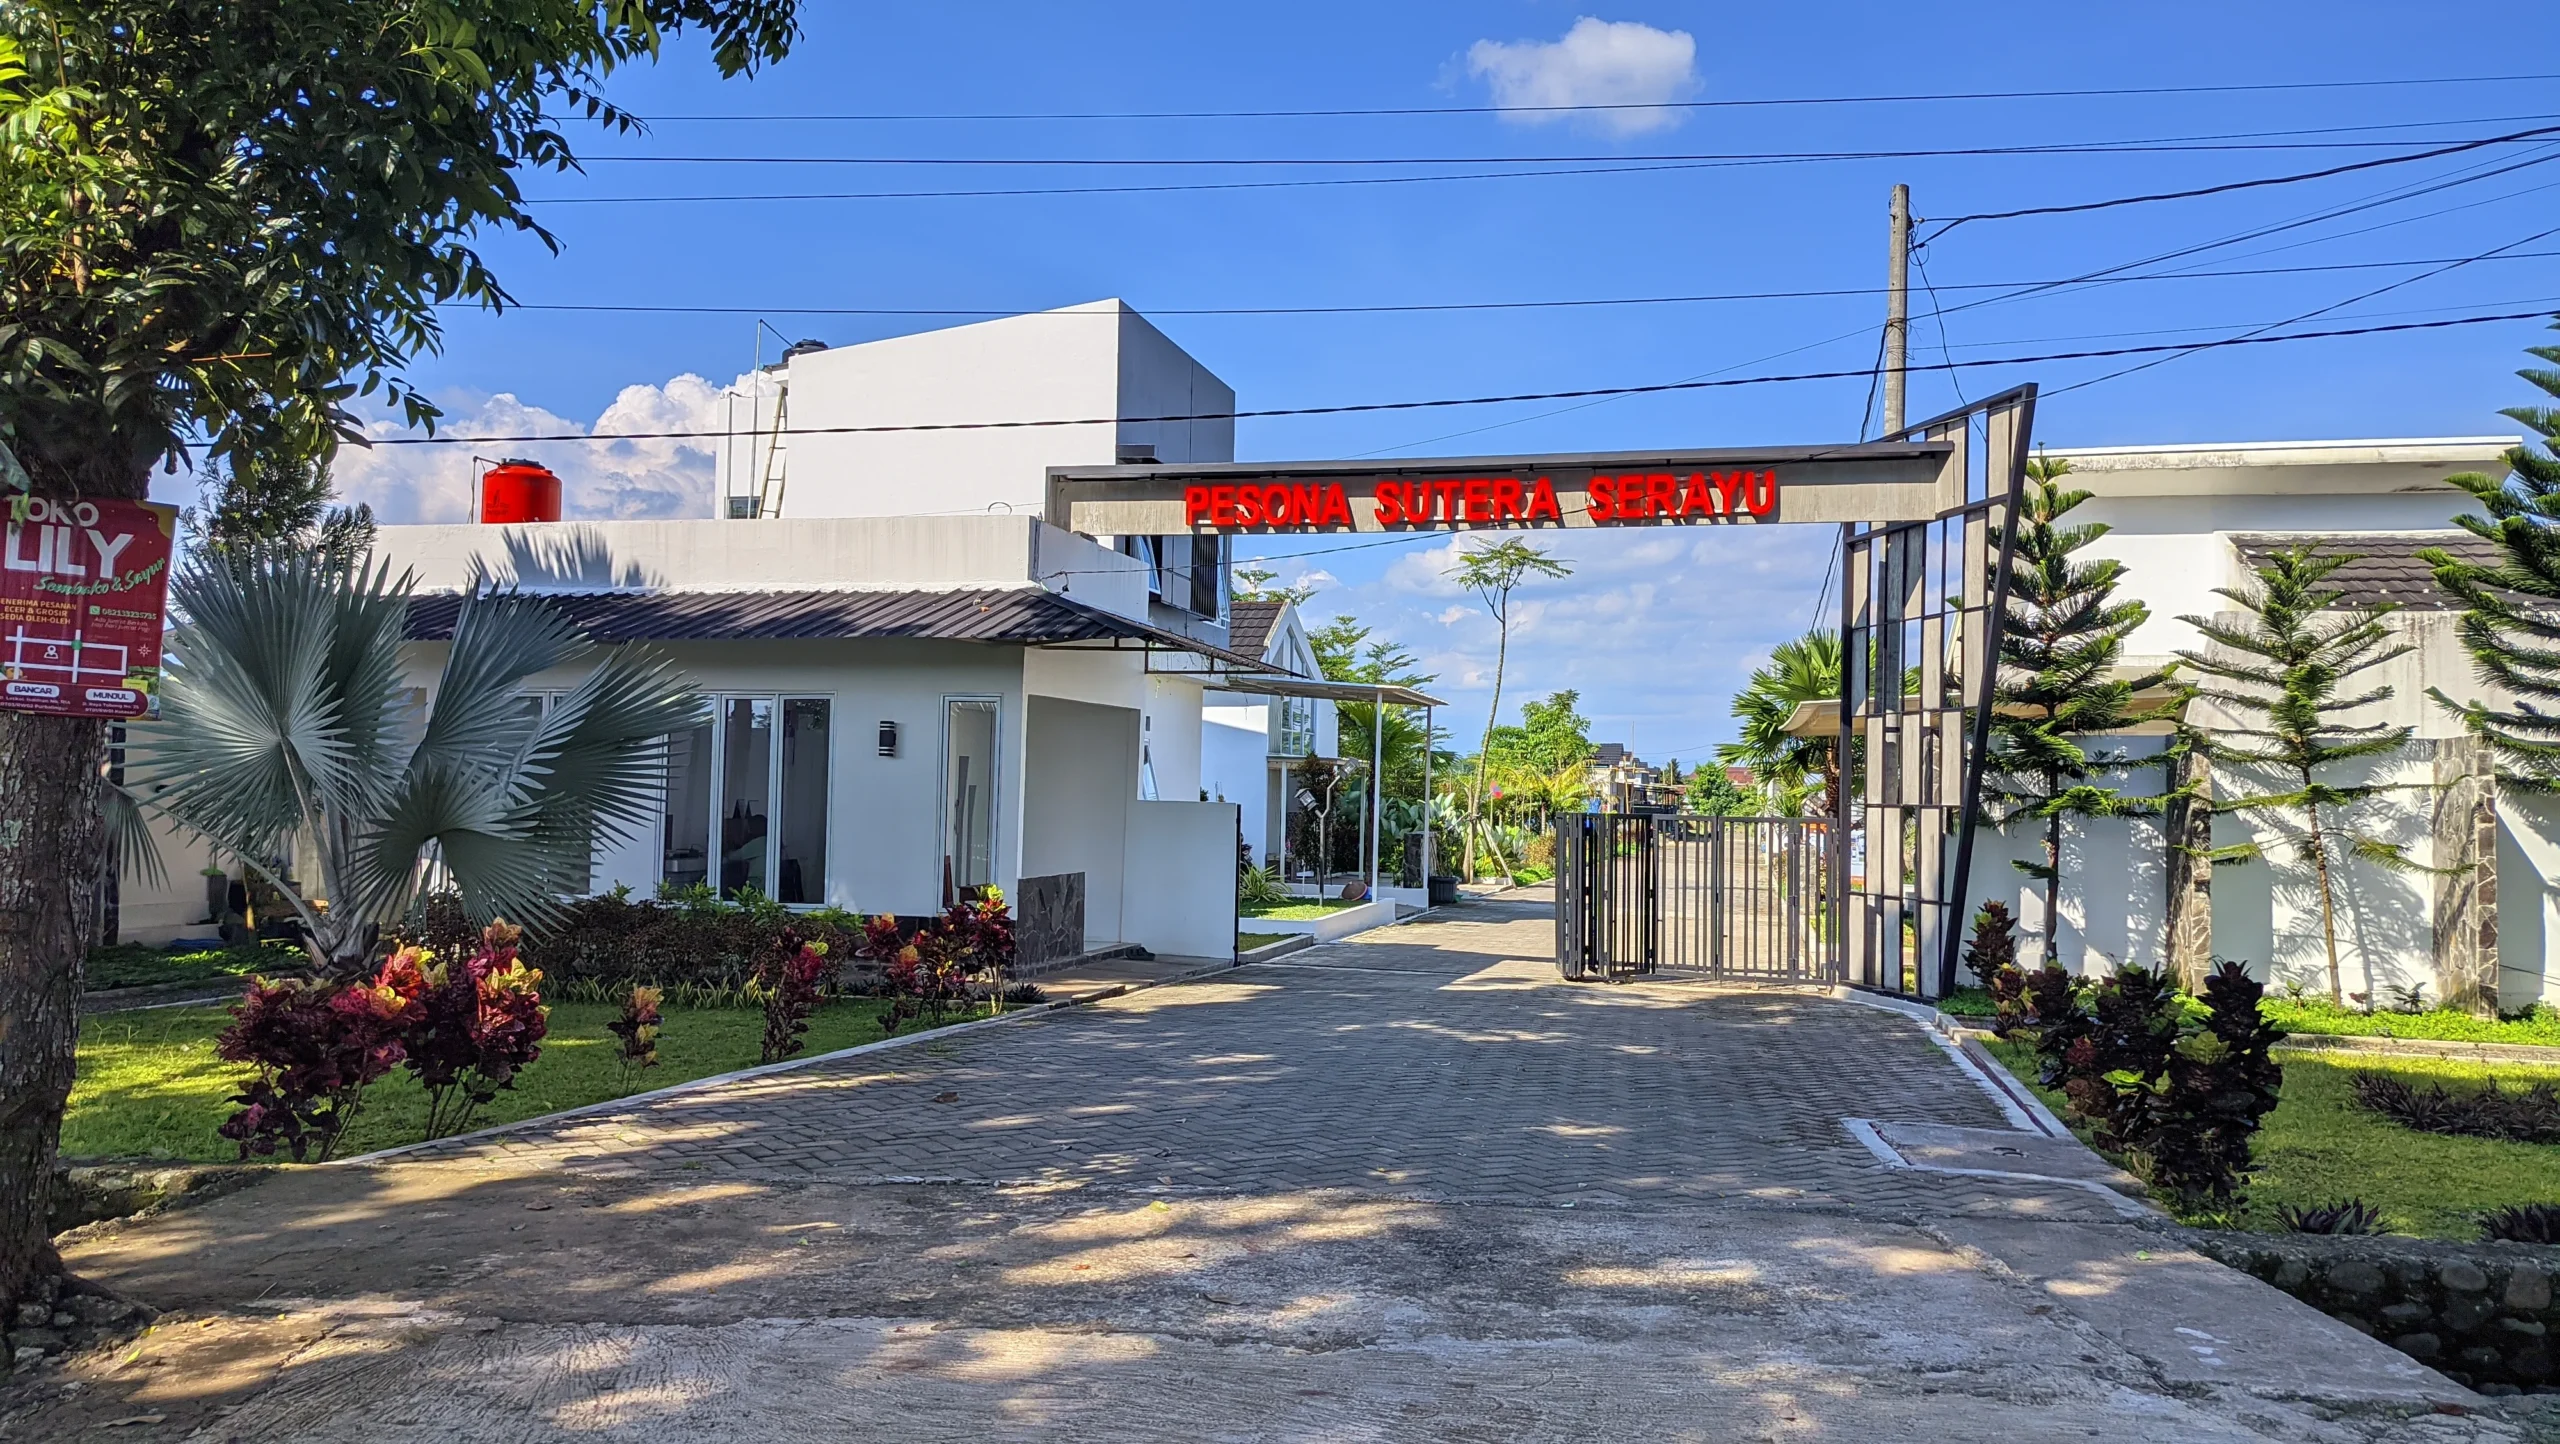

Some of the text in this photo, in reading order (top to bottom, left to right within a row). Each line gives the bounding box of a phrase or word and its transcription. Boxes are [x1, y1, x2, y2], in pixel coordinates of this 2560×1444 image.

[1185, 470, 1775, 526] PESONA SUTERA SERAYU
[4, 494, 99, 527] TOKO
[4, 521, 134, 579] LILY
[111, 576, 122, 592] &
[123, 557, 166, 590] Sayur
[0, 598, 77, 610] ENERIMA PESANAN
[36, 608, 68, 617] GROSIR
[25, 615, 71, 624] OLEH-OLEH
[14, 685, 52, 694] BANCAR
[93, 692, 129, 700] MUNJUL
